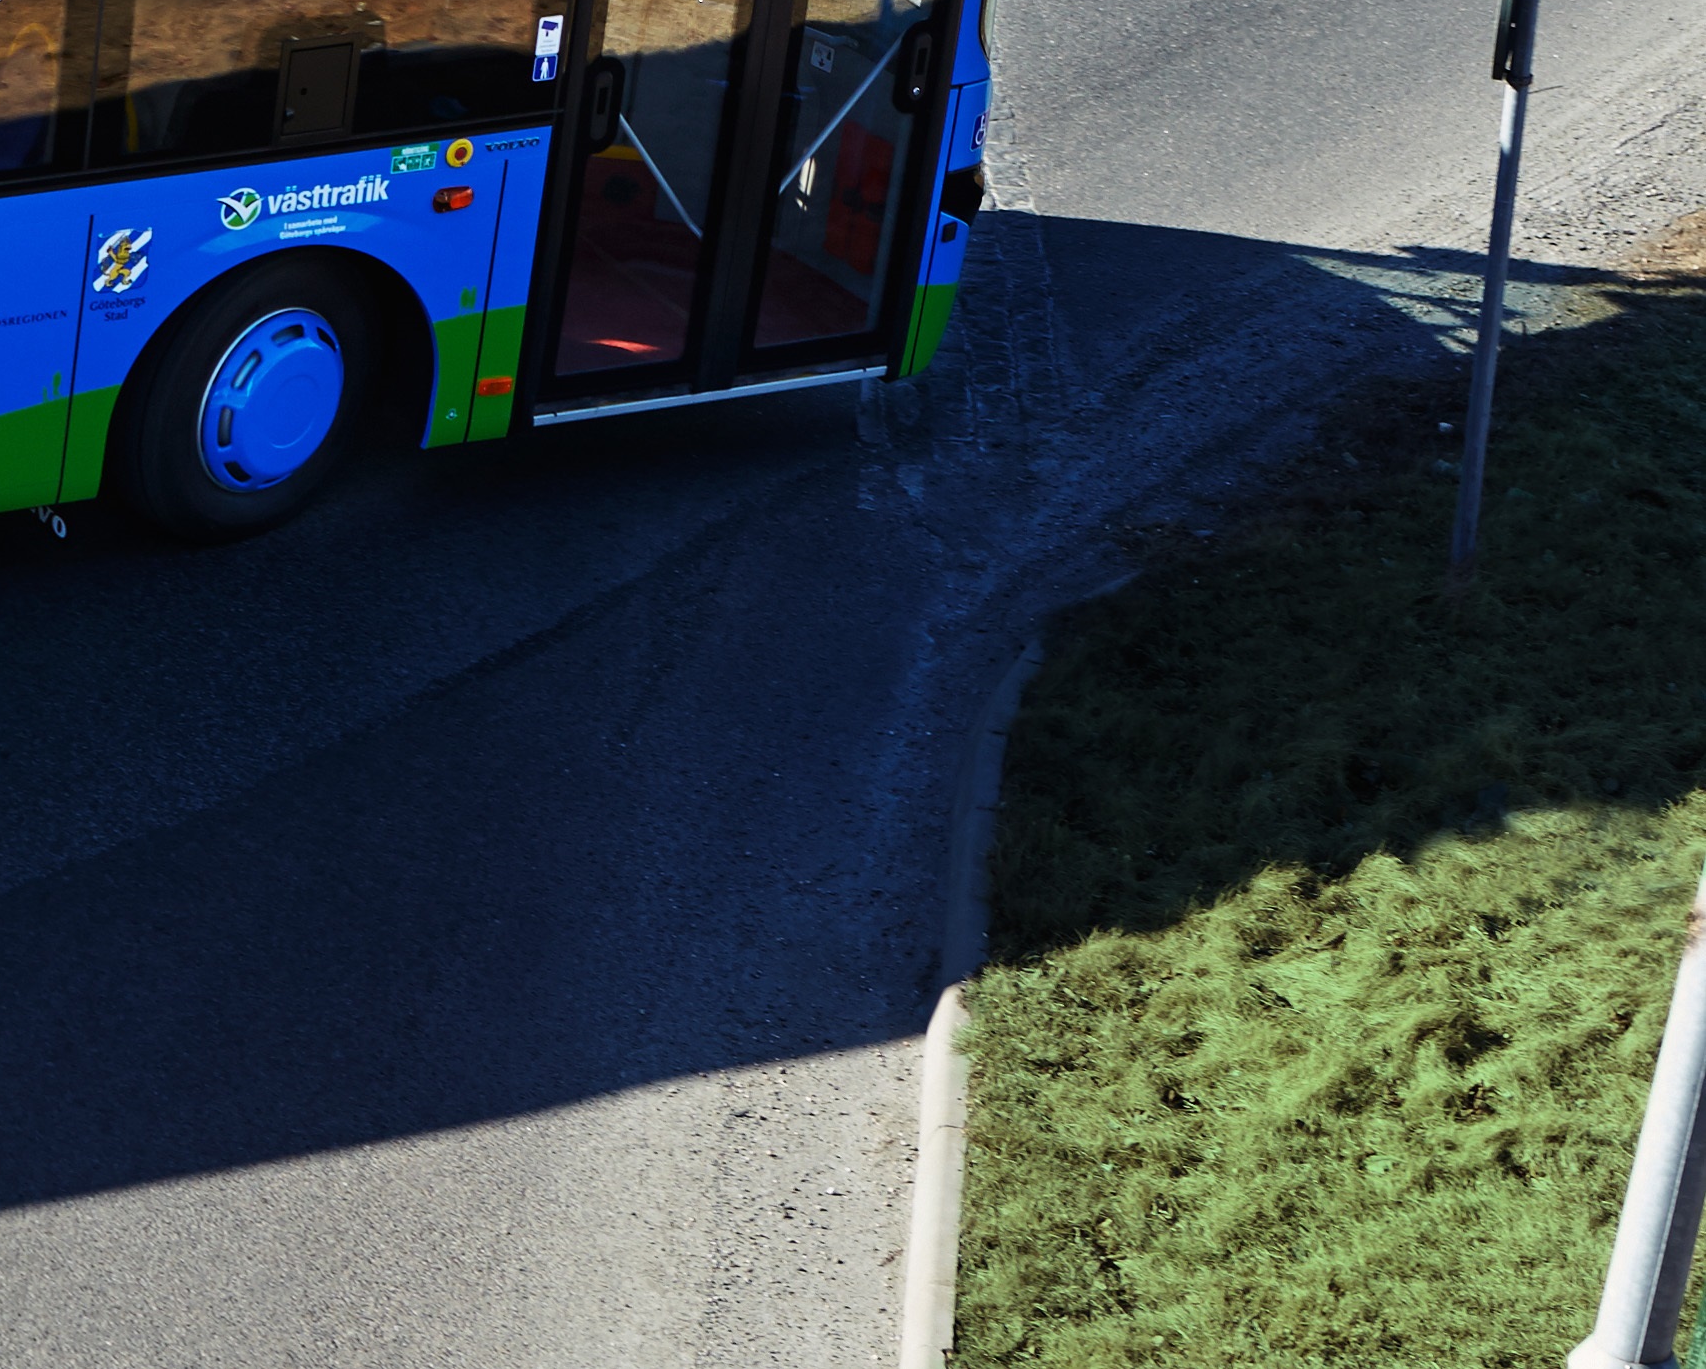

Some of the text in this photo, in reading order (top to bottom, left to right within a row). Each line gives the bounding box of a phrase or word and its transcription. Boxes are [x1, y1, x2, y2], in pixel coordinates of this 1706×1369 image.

[484, 136, 540, 152] VOLVO
[267, 174, 390, 215] västtrafik
[89, 297, 146, 312] Göteborgs
[104, 310, 129, 321] Stad
